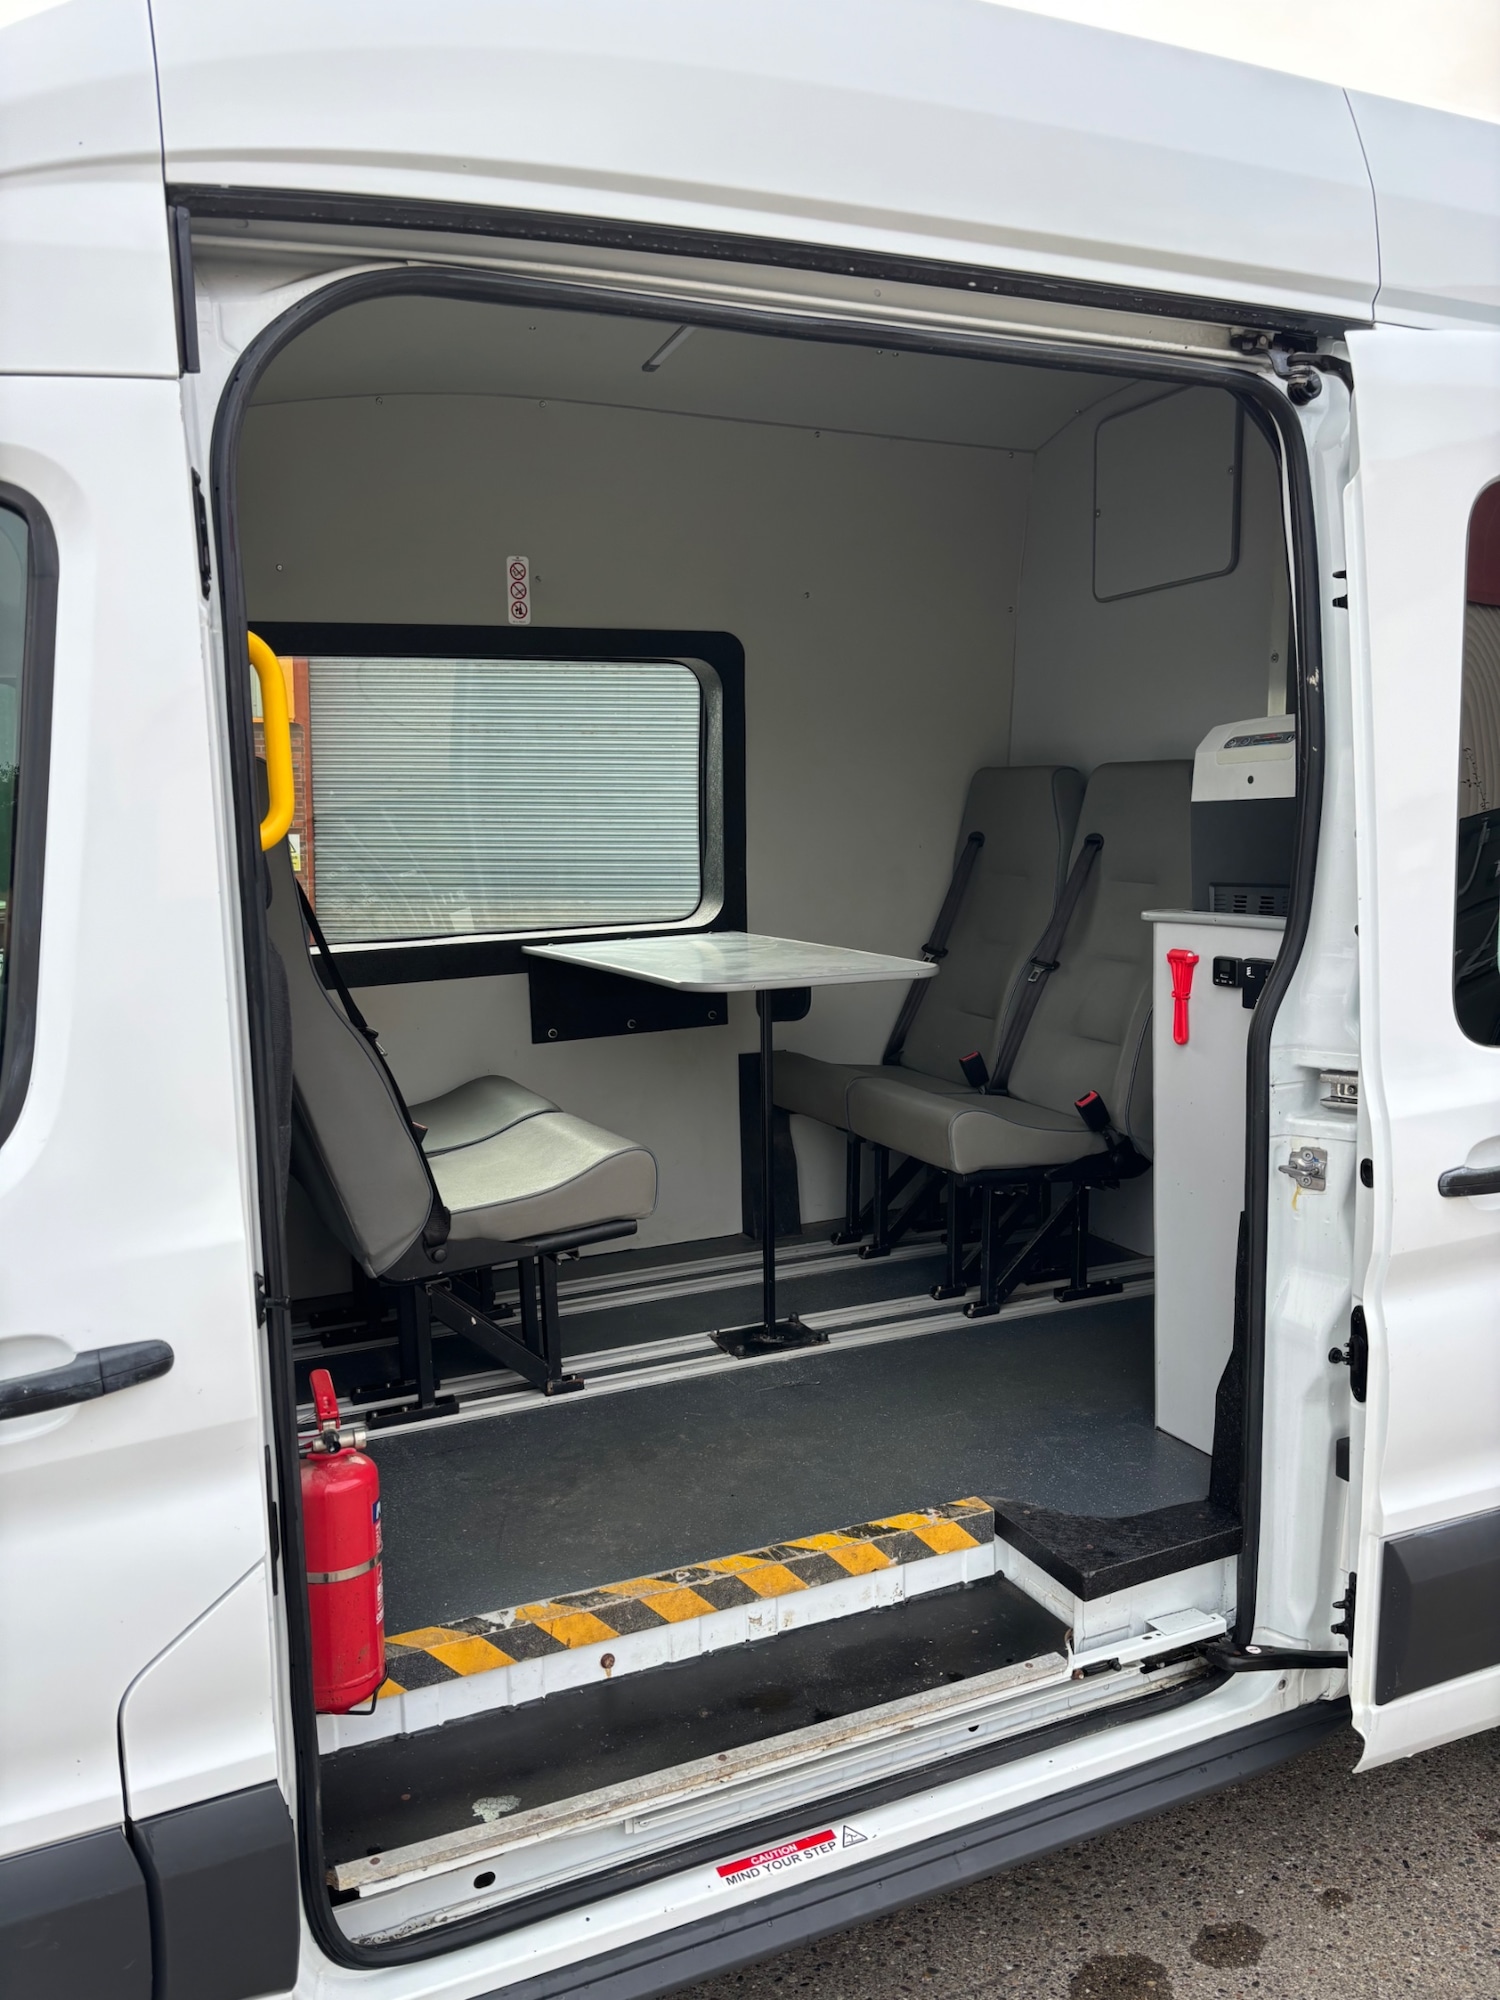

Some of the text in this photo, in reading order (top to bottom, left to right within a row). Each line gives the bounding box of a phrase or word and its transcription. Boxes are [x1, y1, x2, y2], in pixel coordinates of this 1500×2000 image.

[726, 1841, 837, 1886] MIND YOUR STEP
[750, 1843, 798, 1865] CAUTION
